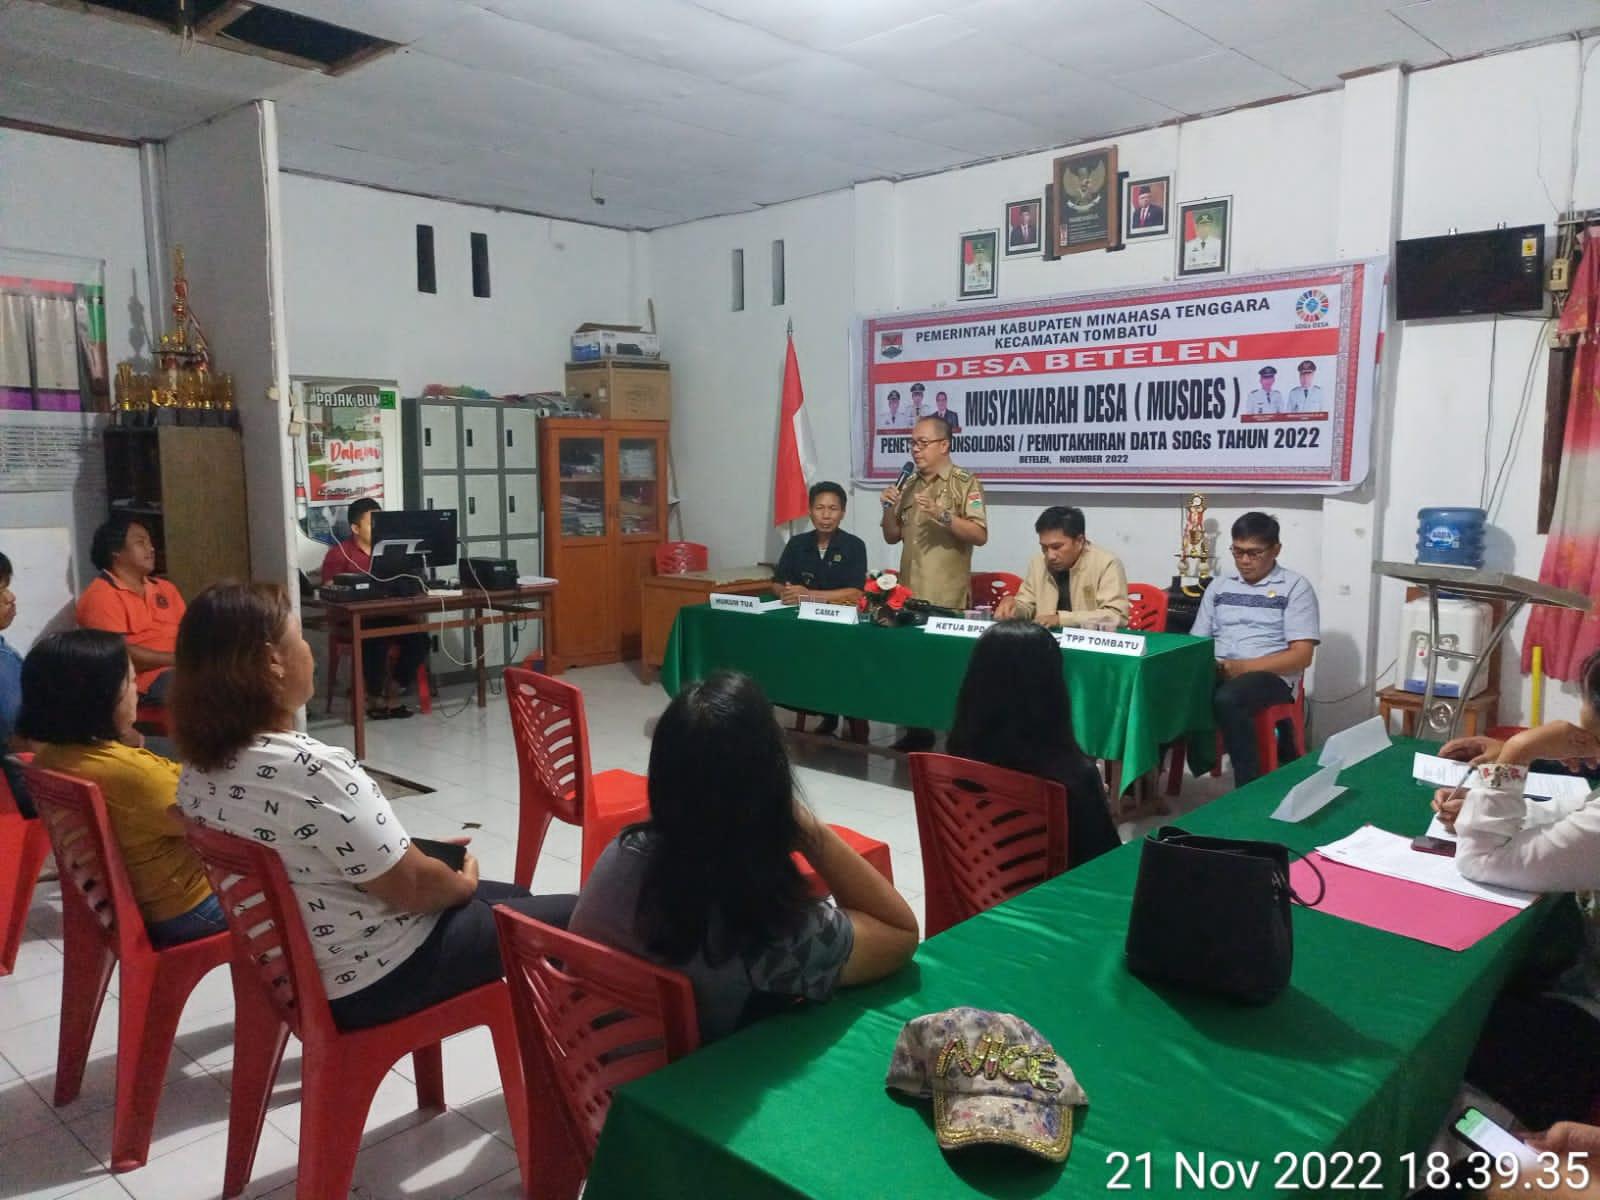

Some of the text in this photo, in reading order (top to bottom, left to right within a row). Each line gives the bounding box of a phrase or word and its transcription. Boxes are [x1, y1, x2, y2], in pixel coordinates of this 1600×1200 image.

[916, 297, 1270, 343] PEMERINTAH KABUPATEN MINAHASA TENGGARA
[995, 324, 1157, 349] KECAMATAN TOMBATU
[936, 340, 1238, 378] DESA BETELEN
[965, 386, 1080, 427] MUSYAWARAH
[1084, 382, 1127, 423] DESA
[1147, 377, 1226, 421] MUSDES
[880, 436, 912, 453] PENET
[950, 434, 1015, 453] ONSOLIDASI
[1027, 431, 1126, 452] PEMUTAKHIRAN
[1130, 431, 1167, 450] DATA
[1172, 430, 1212, 450] SDGs
[1217, 429, 1268, 449] TAHUN
[1273, 427, 1320, 449] 2022
[1059, 455, 1103, 464] NOVEMBER
[1105, 454, 1129, 463] 2022
[740, 600, 753, 608] TUA
[815, 608, 840, 617] CAMAT
[935, 622, 965, 632] KETUA
[1066, 634, 1139, 650] TPP TOMBATU
